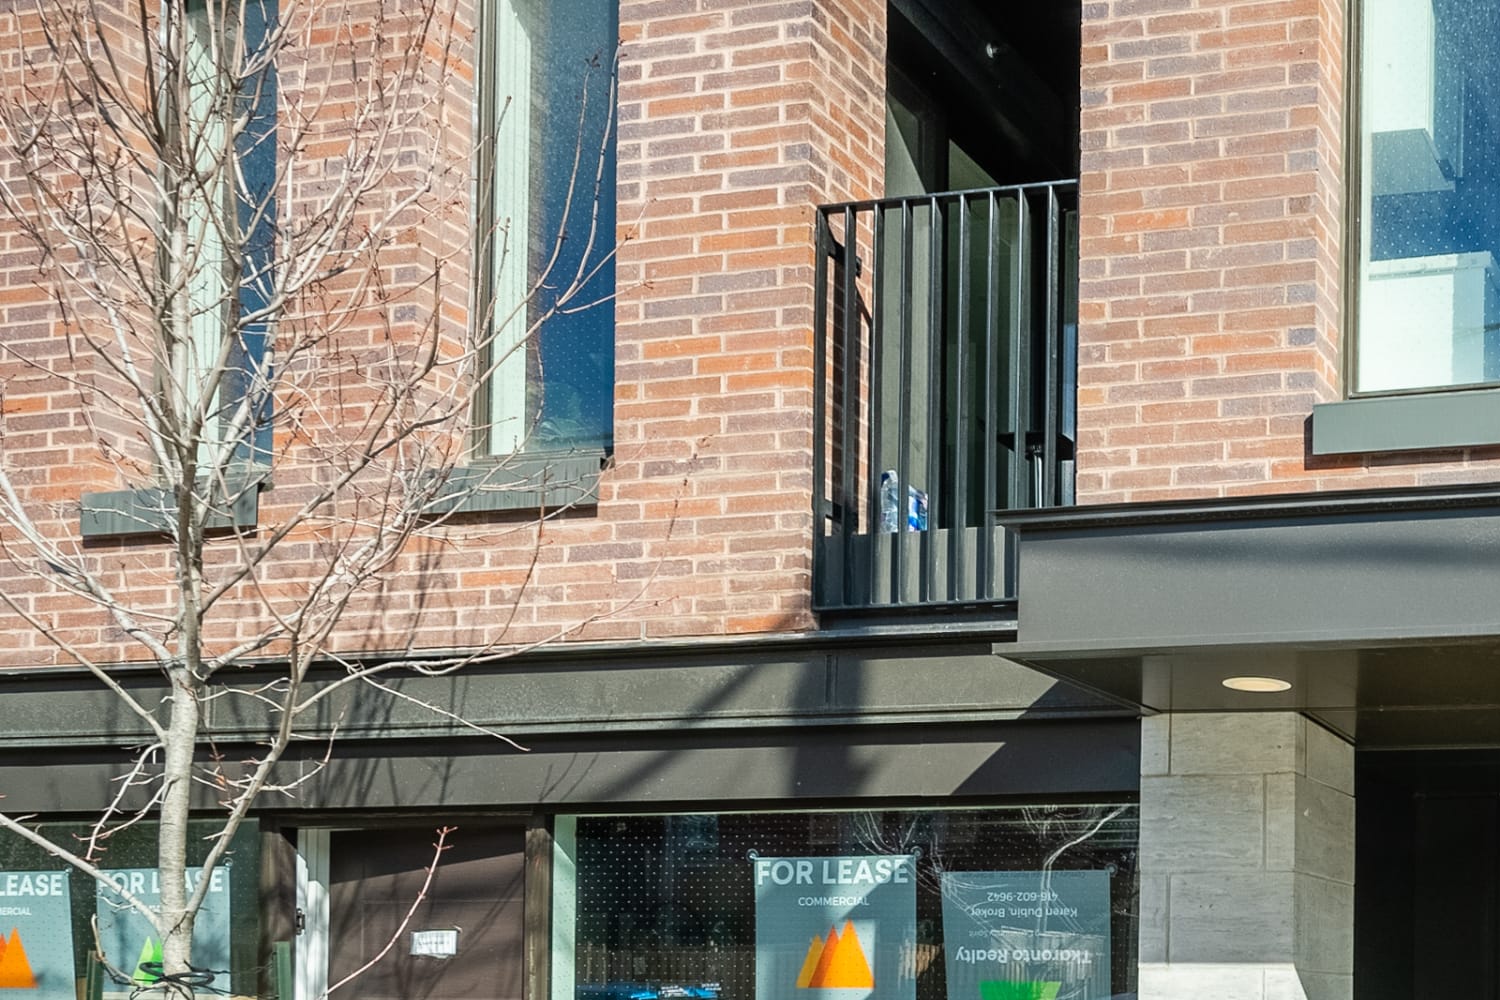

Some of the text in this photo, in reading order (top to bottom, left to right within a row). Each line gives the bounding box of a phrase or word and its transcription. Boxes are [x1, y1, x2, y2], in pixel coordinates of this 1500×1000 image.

[757, 859, 908, 885] FOR LEASE
[798, 896, 870, 907] COMMERCIAL
[987, 891, 1059, 902] 416-602-9642
[970, 907, 1005, 918] Broker
[1046, 907, 1078, 918] Karen
[955, 946, 1092, 964] Tkaronto Realty
